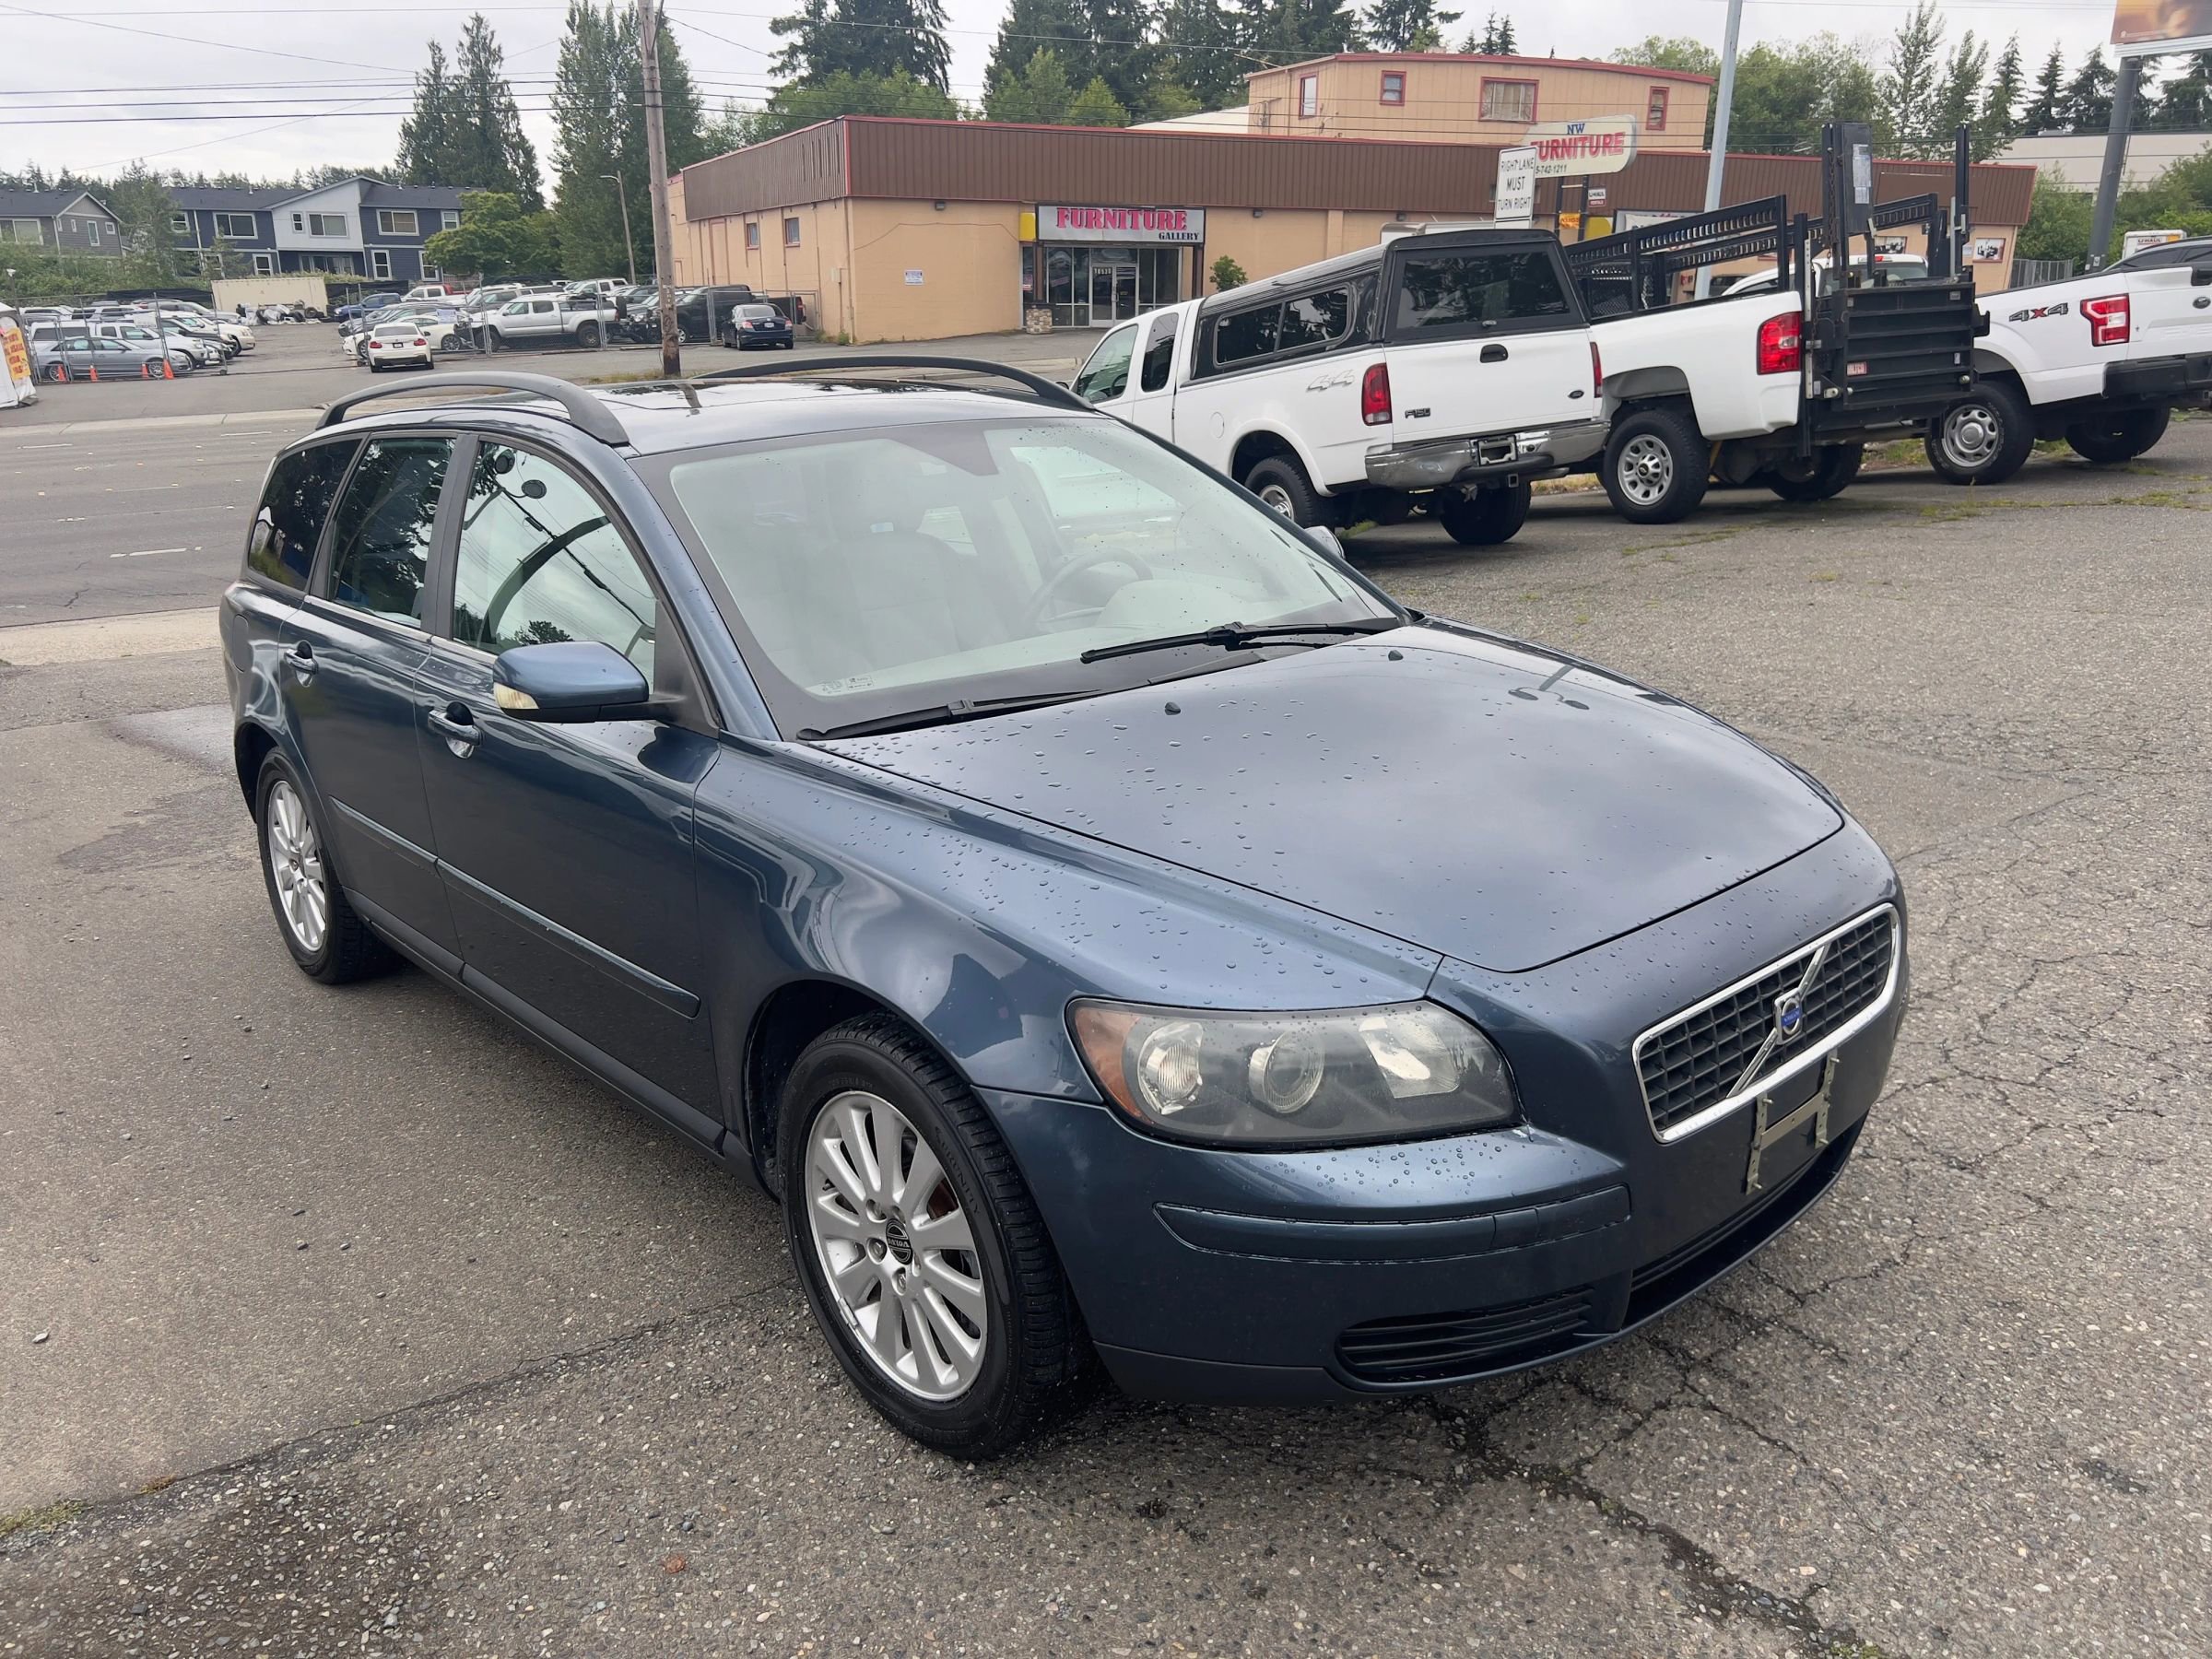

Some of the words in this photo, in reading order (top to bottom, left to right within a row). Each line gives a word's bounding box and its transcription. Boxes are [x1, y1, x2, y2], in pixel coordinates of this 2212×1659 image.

[1567, 124, 1585, 135] NW
[1501, 159, 1518, 171] RIGHT
[1519, 157, 1534, 170] LANE
[1506, 176, 1525, 192] MUST
[1498, 198, 1512, 210] TURN
[1513, 196, 1531, 209] RIGHT
[1056, 207, 1188, 231] FURNITURE
[1159, 232, 1199, 241] GALLERY
